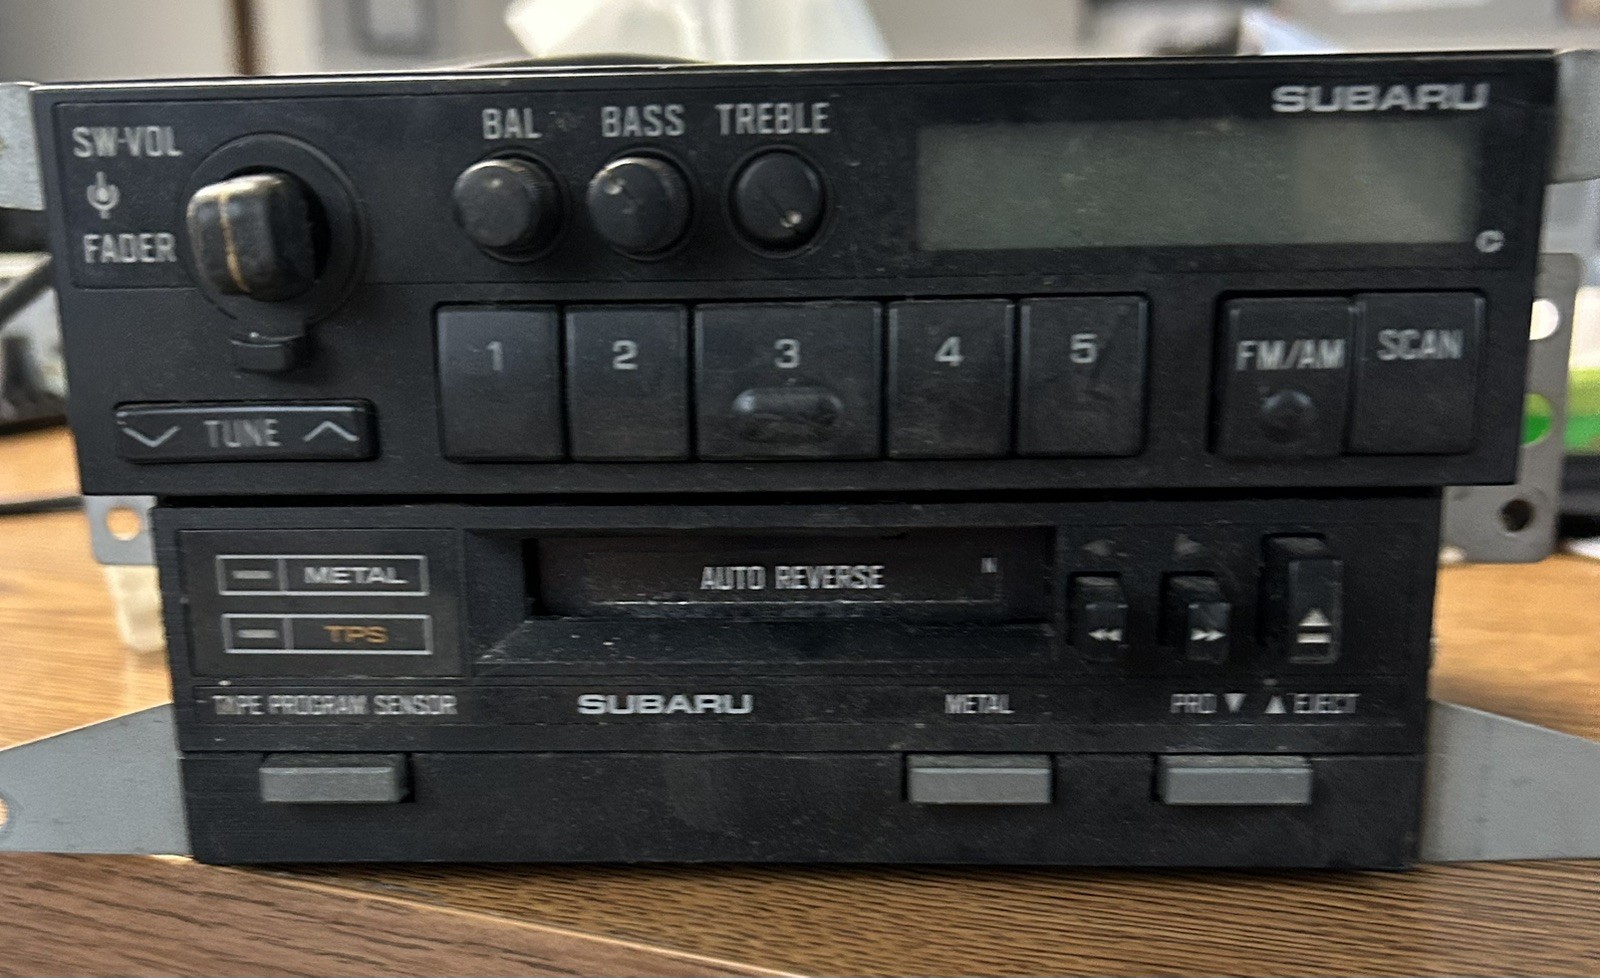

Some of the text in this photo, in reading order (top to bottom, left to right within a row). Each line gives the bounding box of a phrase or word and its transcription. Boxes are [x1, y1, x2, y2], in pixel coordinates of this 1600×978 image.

[1271, 83, 1490, 112] SUBARU
[481, 108, 542, 140] BAL
[601, 104, 685, 138] BASS
[714, 101, 831, 135] TREBLE
[84, 232, 177, 264] FADER
[487, 341, 503, 370] 1
[612, 340, 638, 370] 2
[773, 338, 800, 368] 3
[934, 336, 963, 367] 4
[1069, 333, 1097, 364] 5
[1236, 338, 1346, 371] FM/AM
[1377, 328, 1463, 360] SCAN
[204, 418, 281, 448] TUNE
[303, 566, 408, 585] METAL
[700, 565, 885, 590] AUTO REVERSE
[323, 625, 390, 644] TPS
[213, 694, 458, 716] TAPE PROGRAM SENSOR
[577, 694, 754, 715] SUBARU
[945, 694, 1015, 714] METAL
